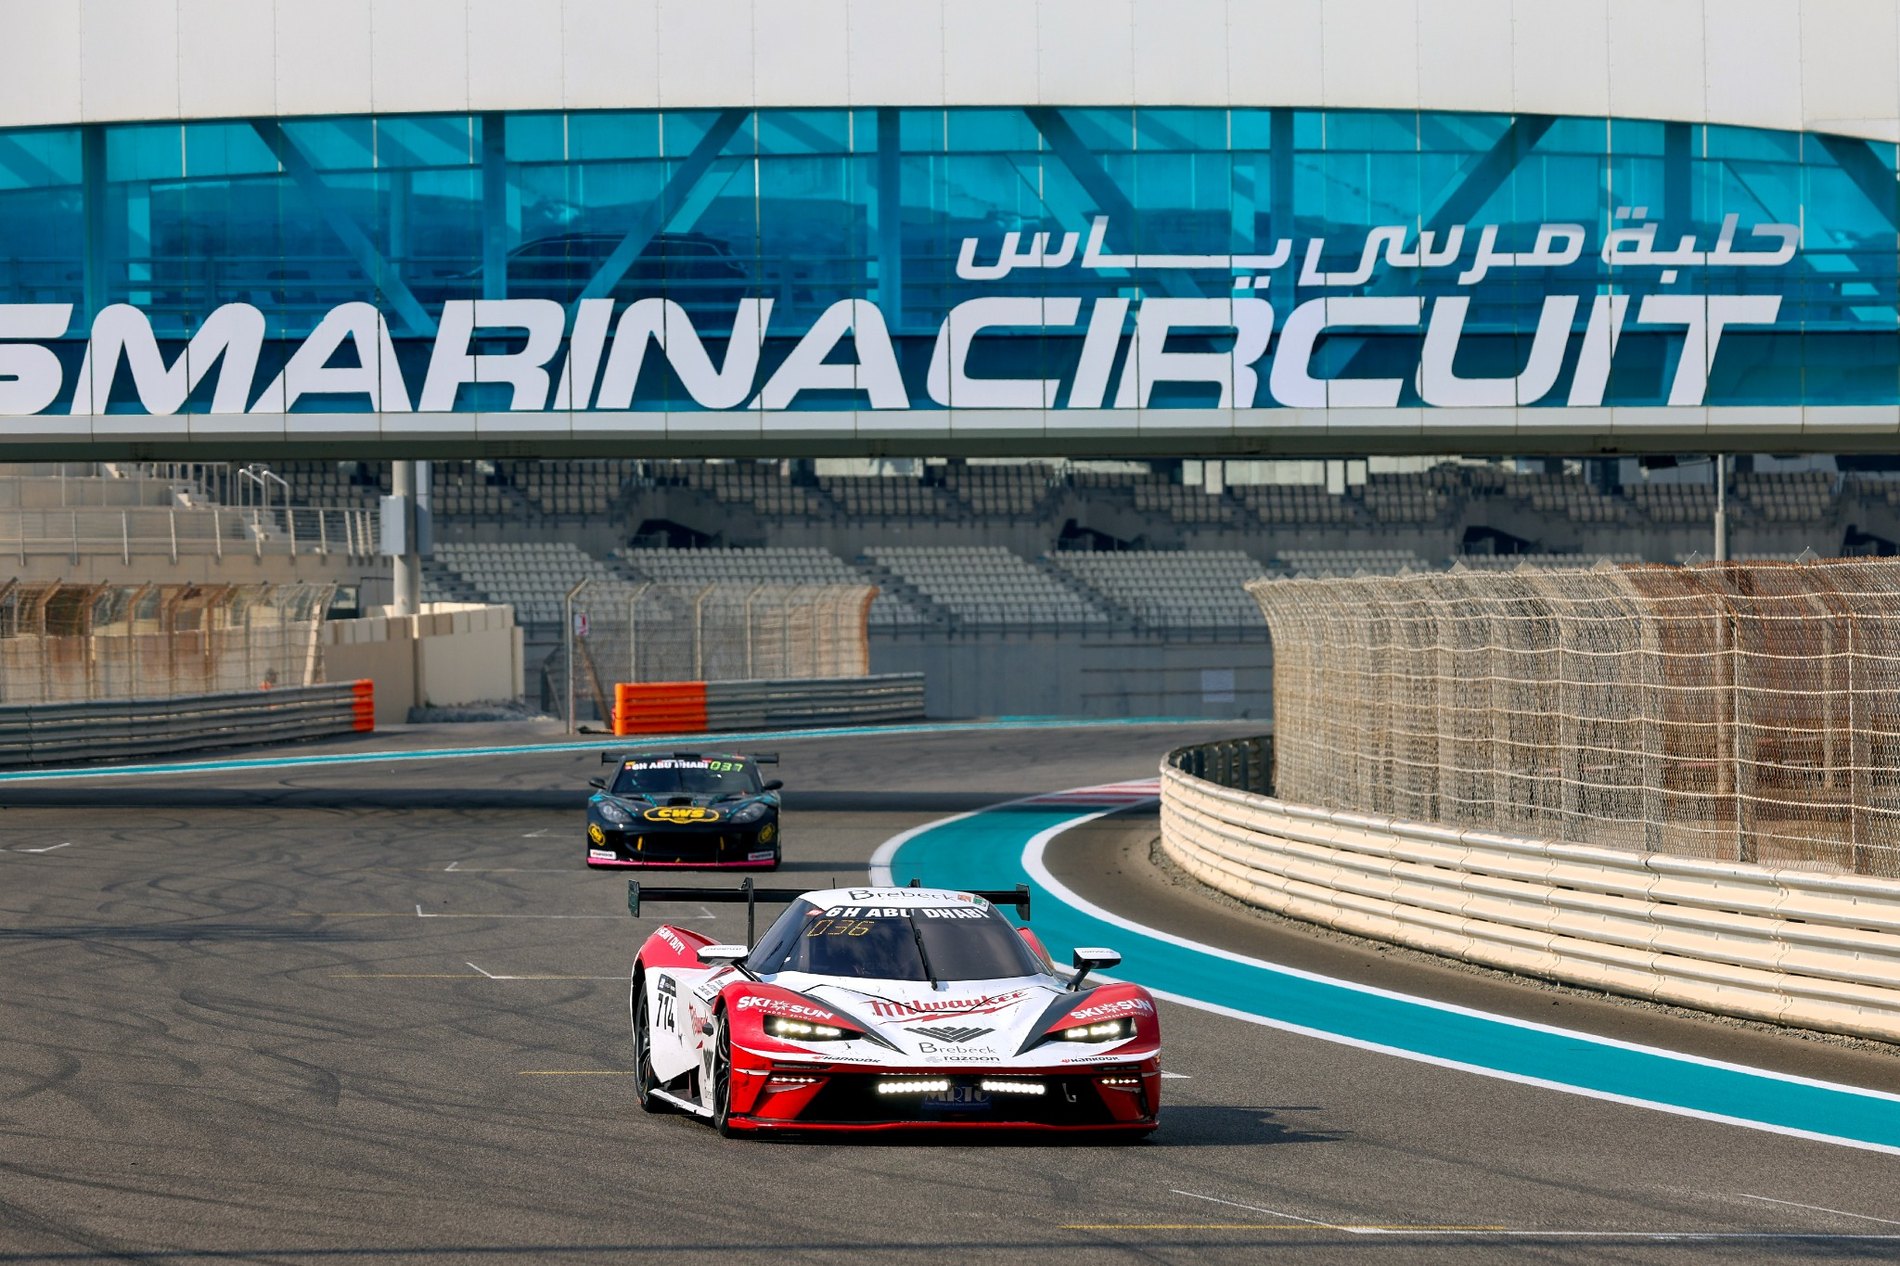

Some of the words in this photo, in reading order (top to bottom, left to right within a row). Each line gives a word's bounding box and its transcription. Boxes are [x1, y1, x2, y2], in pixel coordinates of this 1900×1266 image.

[1601, 206, 1804, 284] حلبة
[69, 297, 912, 415] MARINA
[925, 294, 1783, 409] CIRCUIT
[657, 808, 706, 819] CWS
[825, 907, 858, 918] 6H
[864, 907, 916, 918] ABU
[922, 908, 990, 919] DHABI
[806, 919, 875, 937] 036
[655, 993, 675, 1033] 714
[736, 995, 771, 1009] SKI
[788, 1004, 834, 1020] SUN
[860, 991, 1029, 1018] Milwaukee
[1070, 1006, 1105, 1019] SKI
[1117, 998, 1154, 1013] SUN
[918, 1041, 997, 1054] Brebeck
